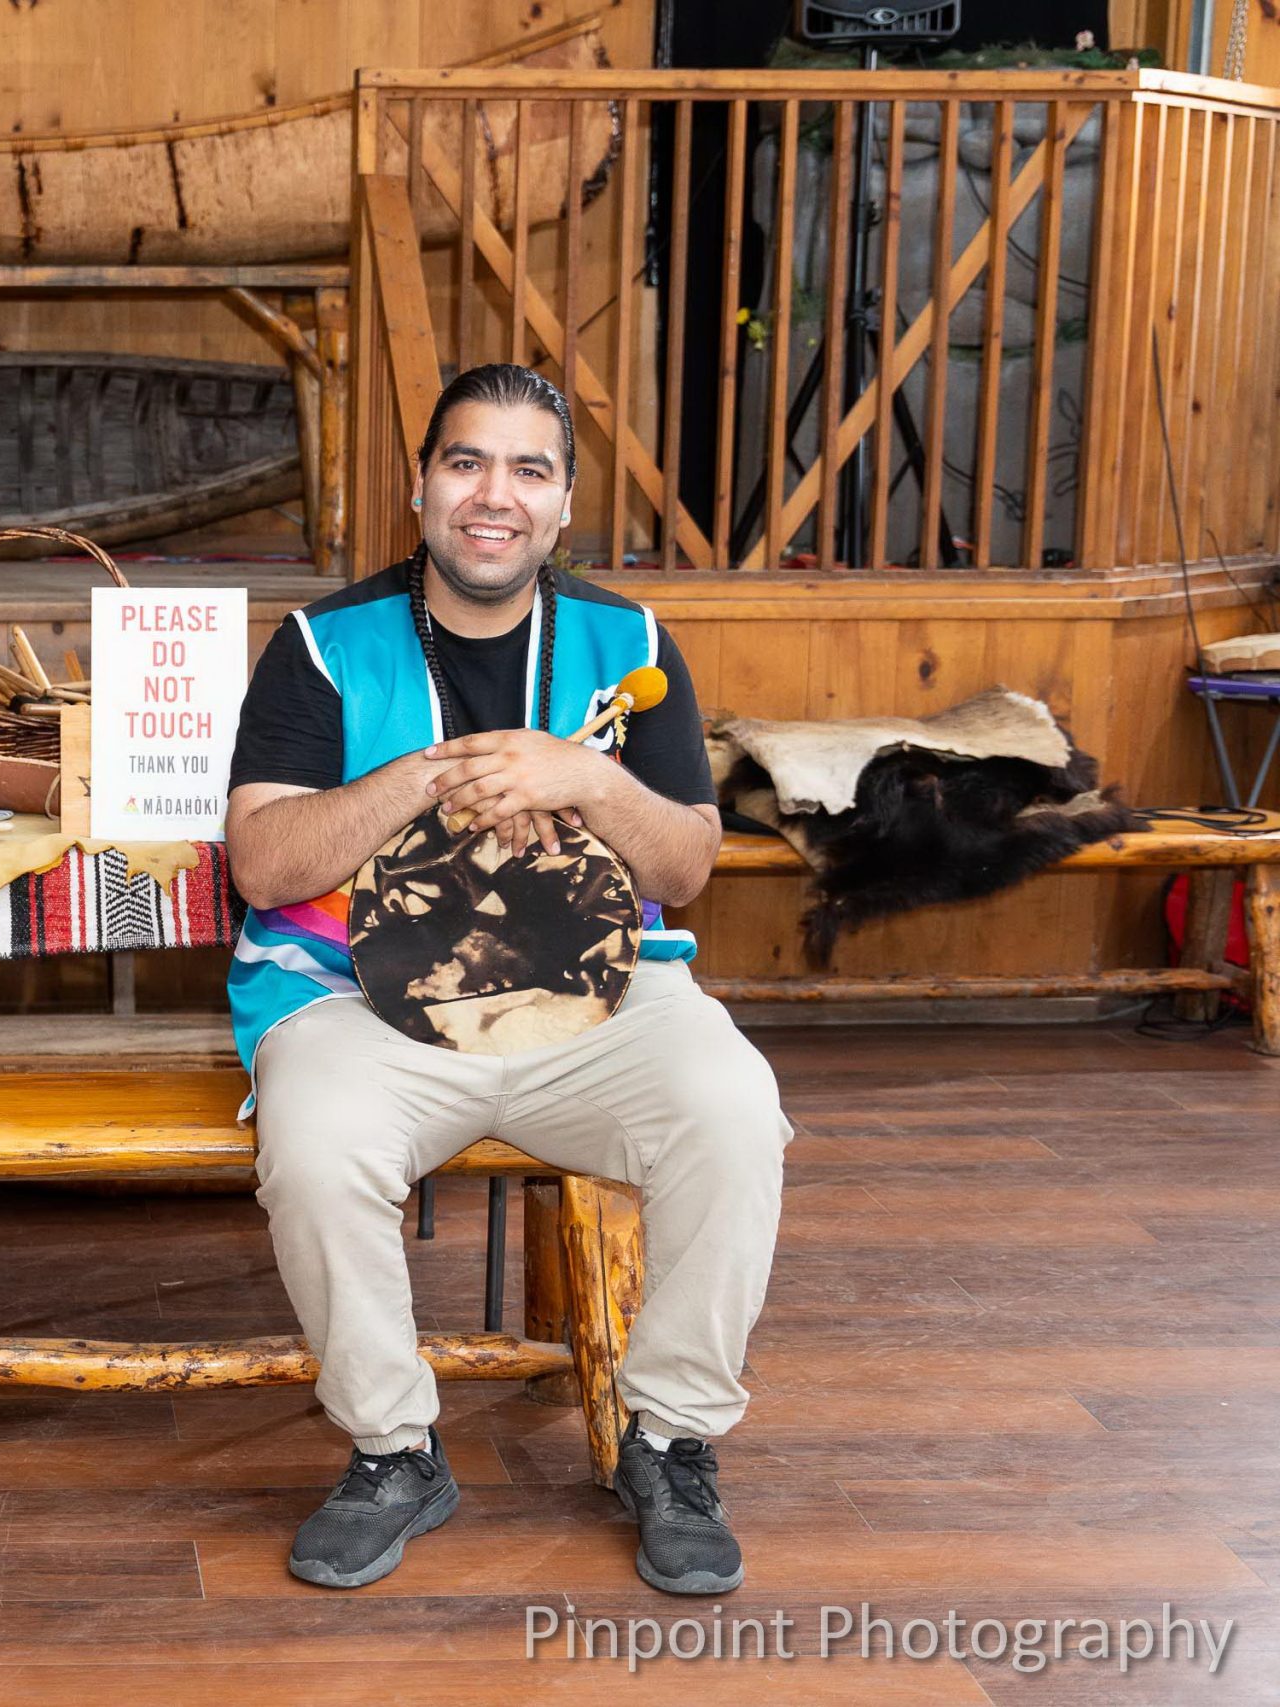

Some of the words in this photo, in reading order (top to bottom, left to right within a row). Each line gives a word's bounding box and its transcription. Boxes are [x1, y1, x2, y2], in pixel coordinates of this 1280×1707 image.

[121, 605, 218, 632] PLEASE
[152, 641, 186, 667] DO
[144, 676, 195, 703] NOT
[125, 712, 212, 739] TOUCH
[129, 755, 175, 774] THANK
[182, 755, 209, 774] YOU
